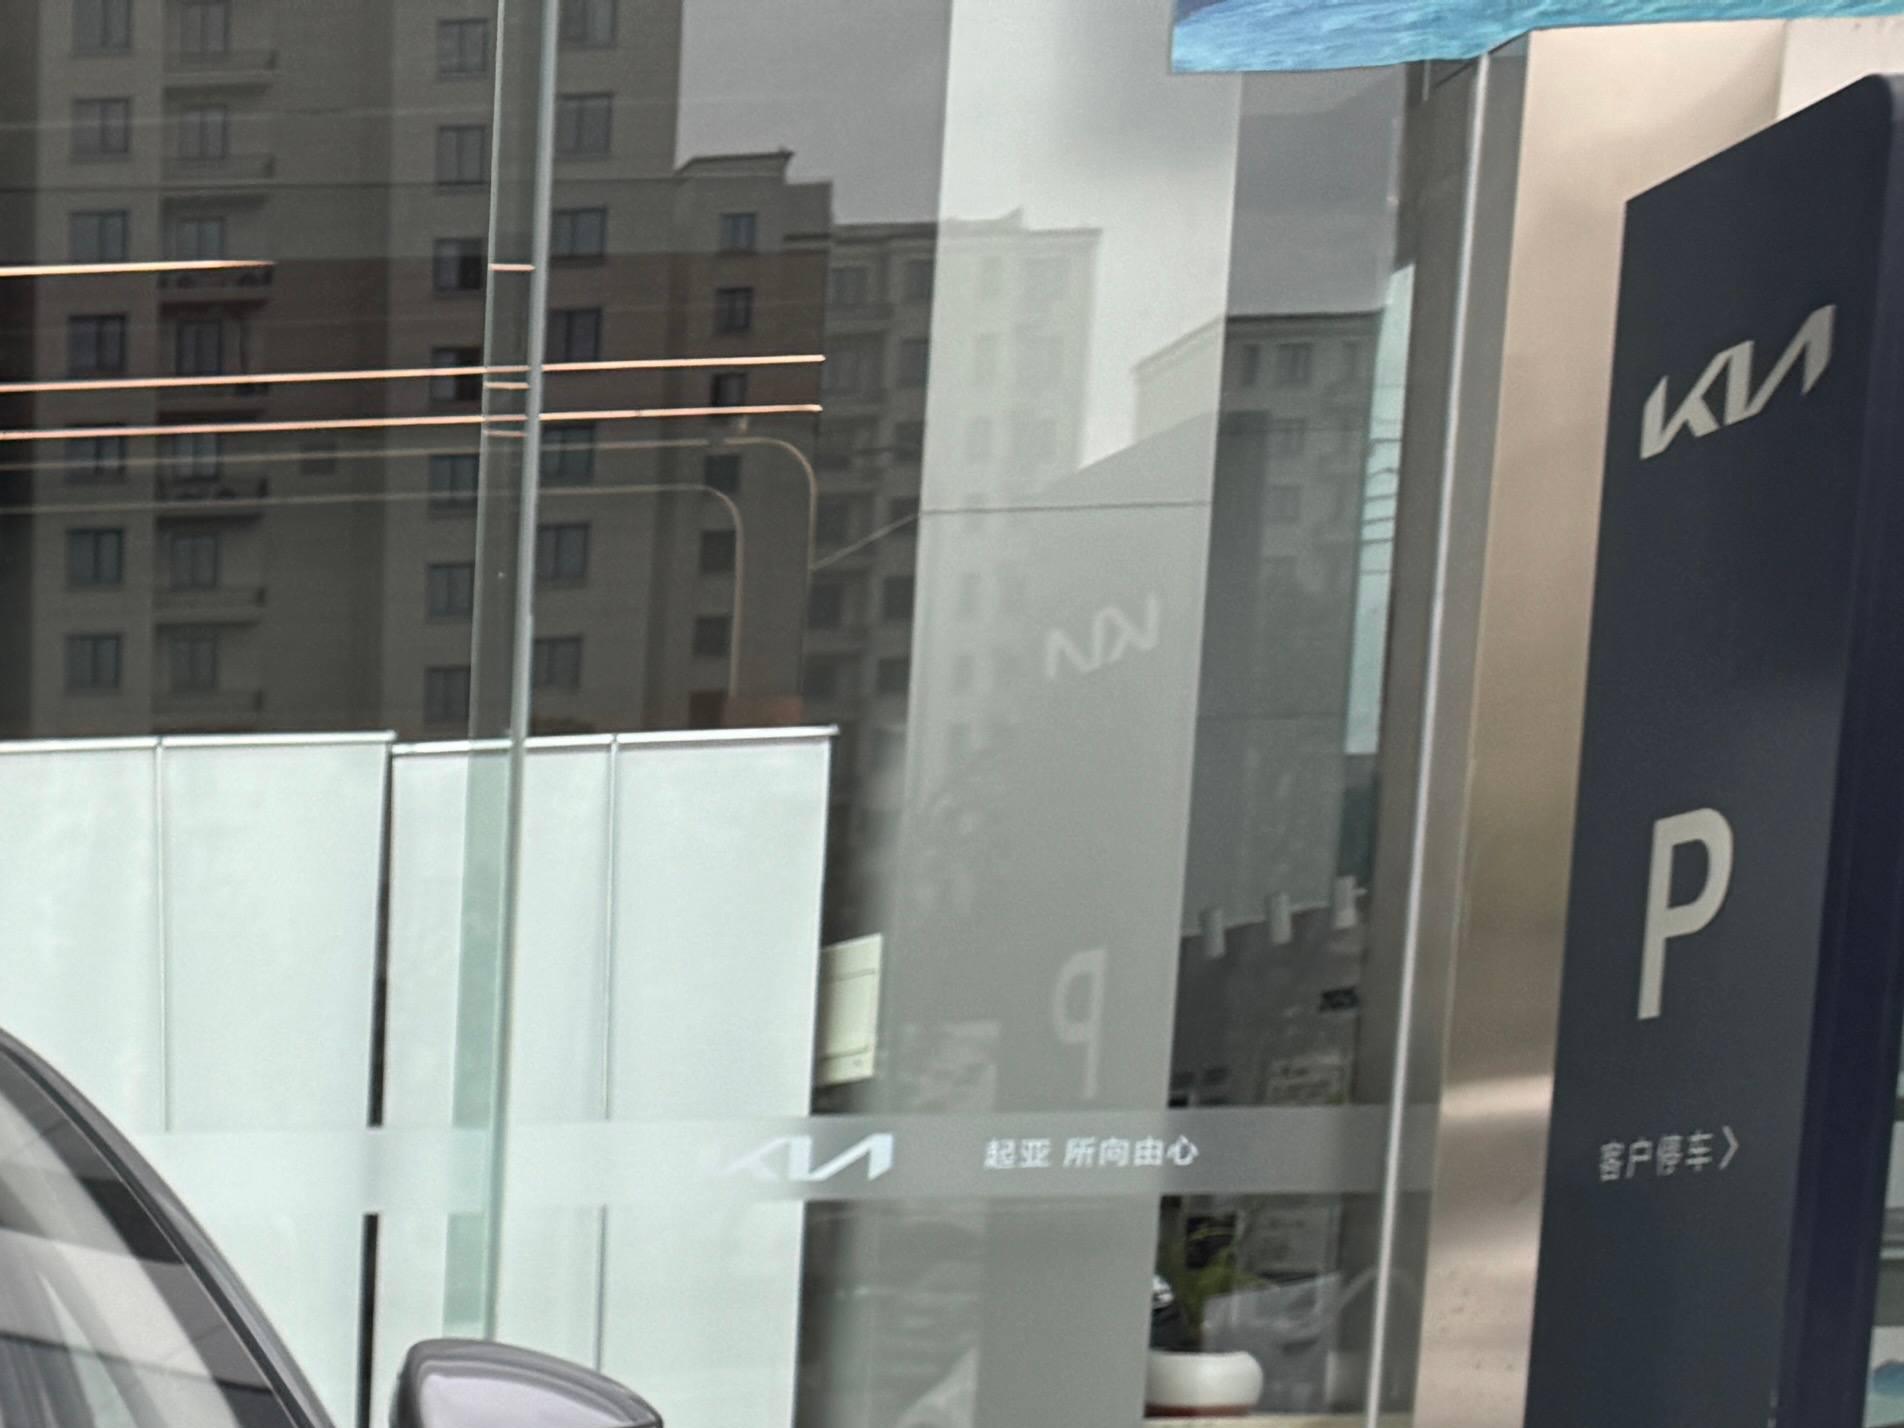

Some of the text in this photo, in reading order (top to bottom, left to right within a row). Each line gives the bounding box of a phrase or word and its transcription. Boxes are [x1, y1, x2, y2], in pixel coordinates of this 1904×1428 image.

[1639, 303, 1837, 459] KIA
[1637, 807, 1733, 1020] P
[984, 1135, 1199, 1168] 起亚 所向由心
[1598, 1131, 1715, 1182] 客户停车
